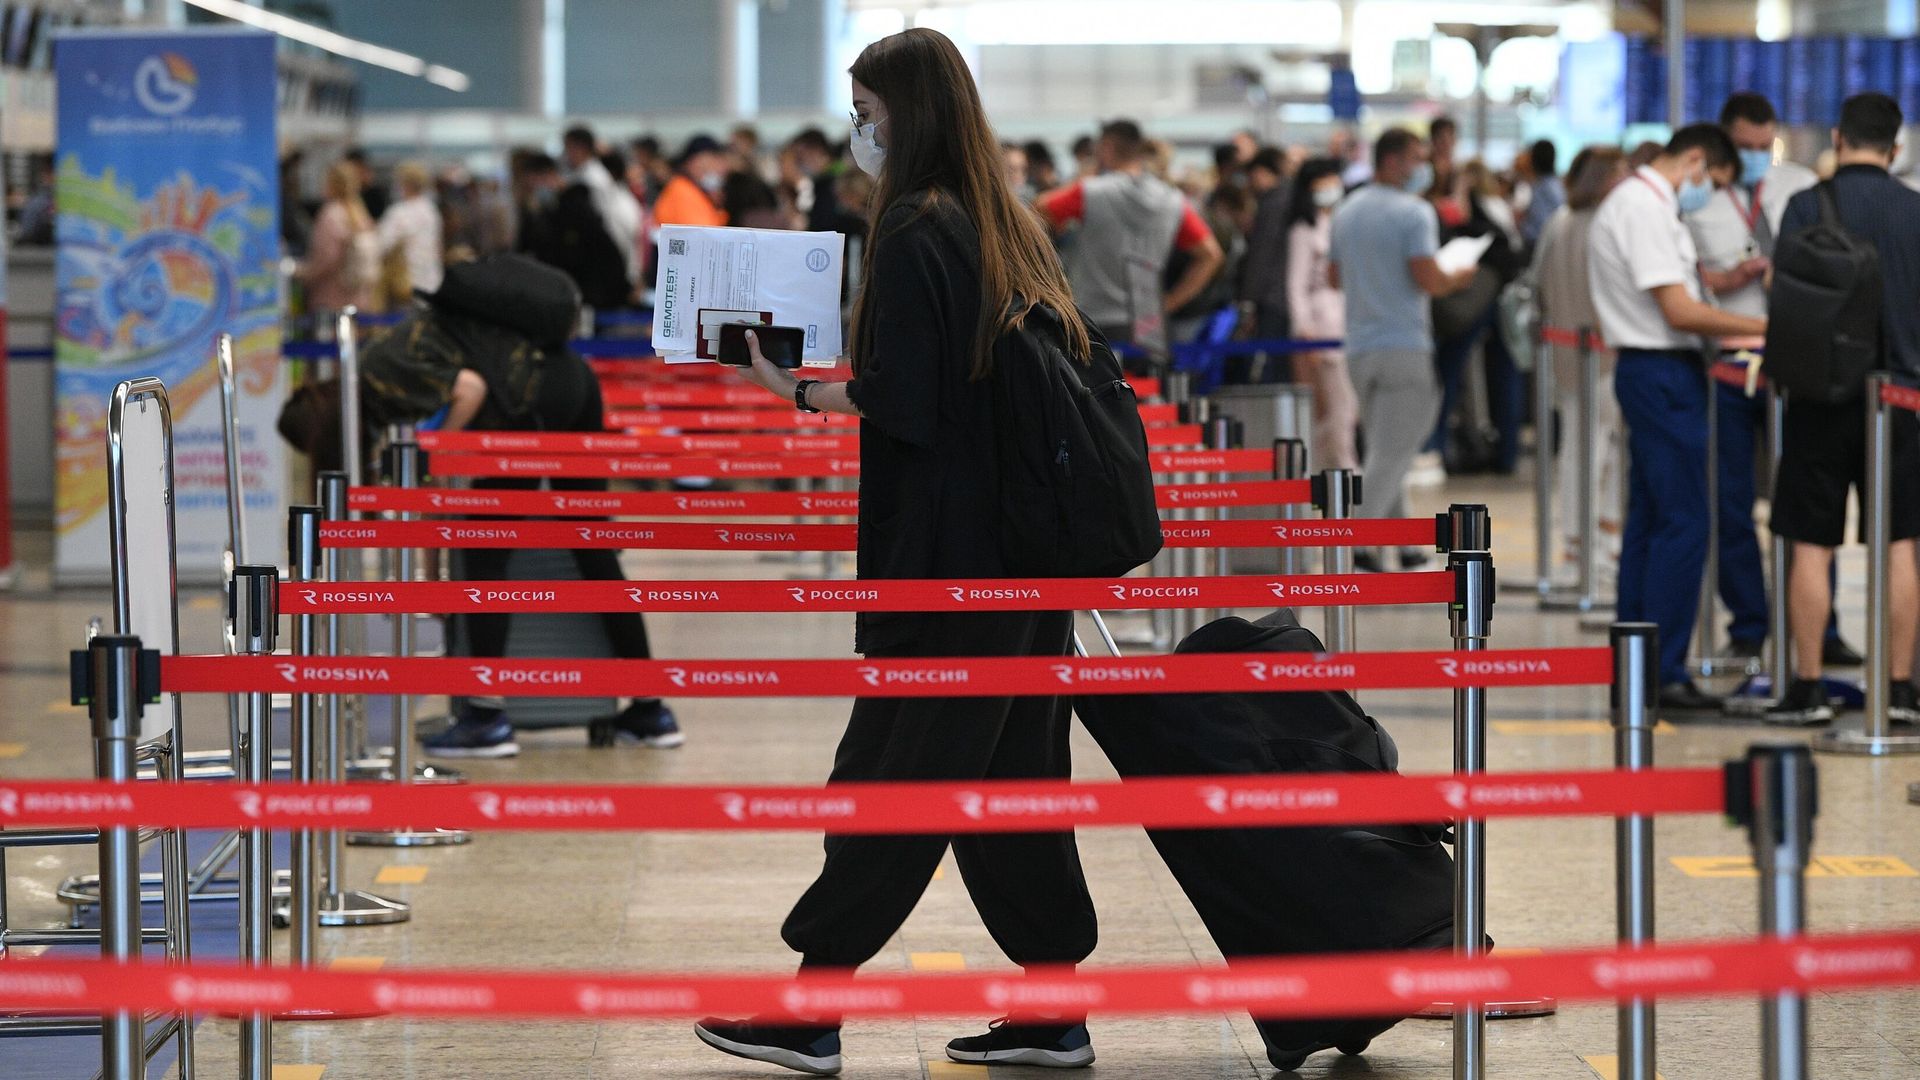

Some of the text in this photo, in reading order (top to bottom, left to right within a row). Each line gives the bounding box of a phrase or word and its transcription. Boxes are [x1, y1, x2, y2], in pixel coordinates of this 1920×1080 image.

[663, 267, 675, 338] GEMOTEST
[814, 498, 859, 508] РОССИ
[318, 529, 377, 539] РОССИЯ
[456, 529, 518, 539] ROSSIYA
[595, 529, 655, 540] РОССИЯ
[734, 532, 796, 542] ROSSIYA
[1161, 528, 1211, 538] ОССИЯ
[1292, 527, 1354, 537] ROSSIYA
[487, 591, 555, 601] РОССИЯ
[648, 590, 719, 601] ROSSIYA
[810, 590, 878, 600] РОССИЯ
[969, 589, 1041, 599] ROSSIYA
[1131, 586, 1199, 598] РОССИЯ
[1290, 584, 1360, 595] ROSSIYA
[322, 592, 394, 603] ROSSIYA
[302, 667, 390, 681] ROSSIYA
[1078, 667, 1166, 681] ROSSIYA
[1271, 664, 1356, 678] РОССИЯ
[1463, 660, 1551, 674] ROSSIYA
[498, 669, 582, 684] РОССИЯ
[691, 670, 779, 685] ROSSIYA
[885, 669, 969, 684] РОССИЯ
[1231, 788, 1339, 809] РОССИЯ
[1465, 784, 1582, 805] ROSSIYA
[23, 793, 134, 812] ROSSIYA
[265, 795, 373, 815] РОССИЯ
[504, 797, 615, 816] ROSSIYA
[749, 797, 857, 818] РОССИЯ
[986, 794, 1099, 815] ROSSIYA
